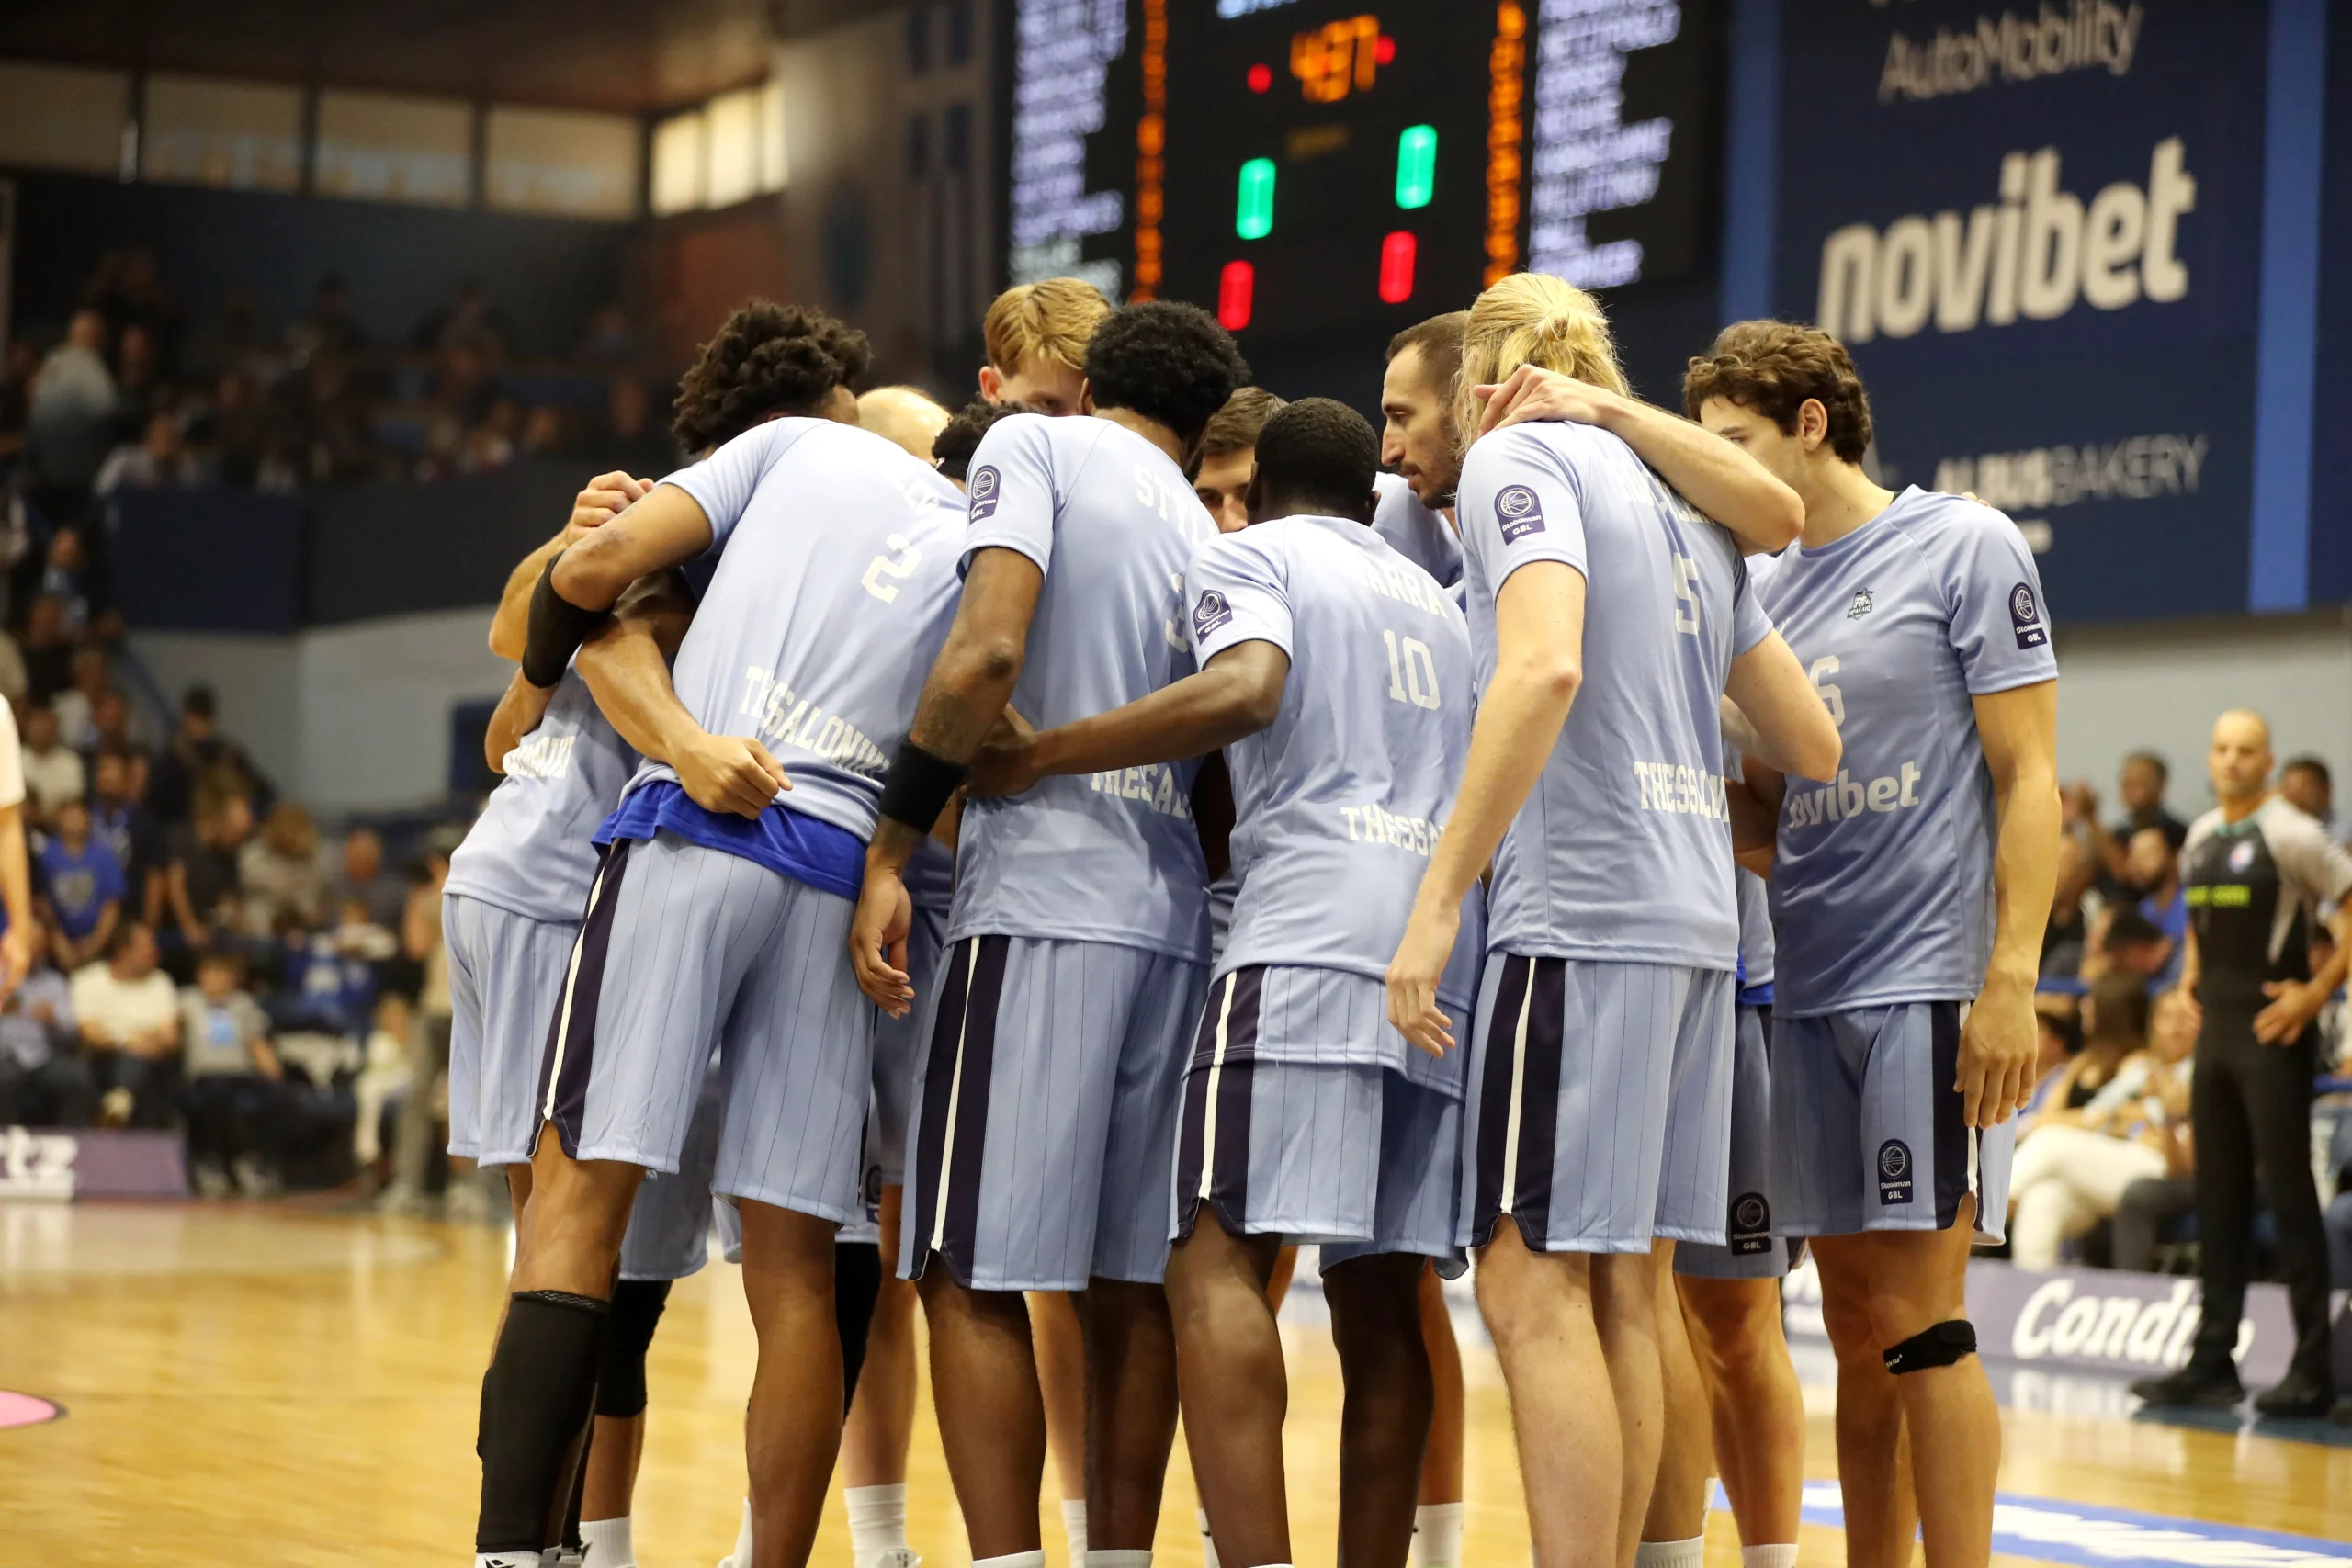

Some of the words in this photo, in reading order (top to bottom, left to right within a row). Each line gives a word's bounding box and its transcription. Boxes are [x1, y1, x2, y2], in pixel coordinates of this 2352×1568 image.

[1815, 135, 2197, 344] novibet
[1133, 462, 1220, 549] STYL
[1512, 524, 1533, 535] GBL
[860, 533, 923, 604] 2
[1673, 552, 1700, 636] 5
[1383, 628, 1441, 711] 10
[2027, 633, 2041, 643] GBL
[1809, 654, 1845, 728] 6
[1887, 1190, 1904, 1200] GBL
[1743, 1241, 1762, 1250] GBL
[2011, 1277, 2256, 1370] Condi
